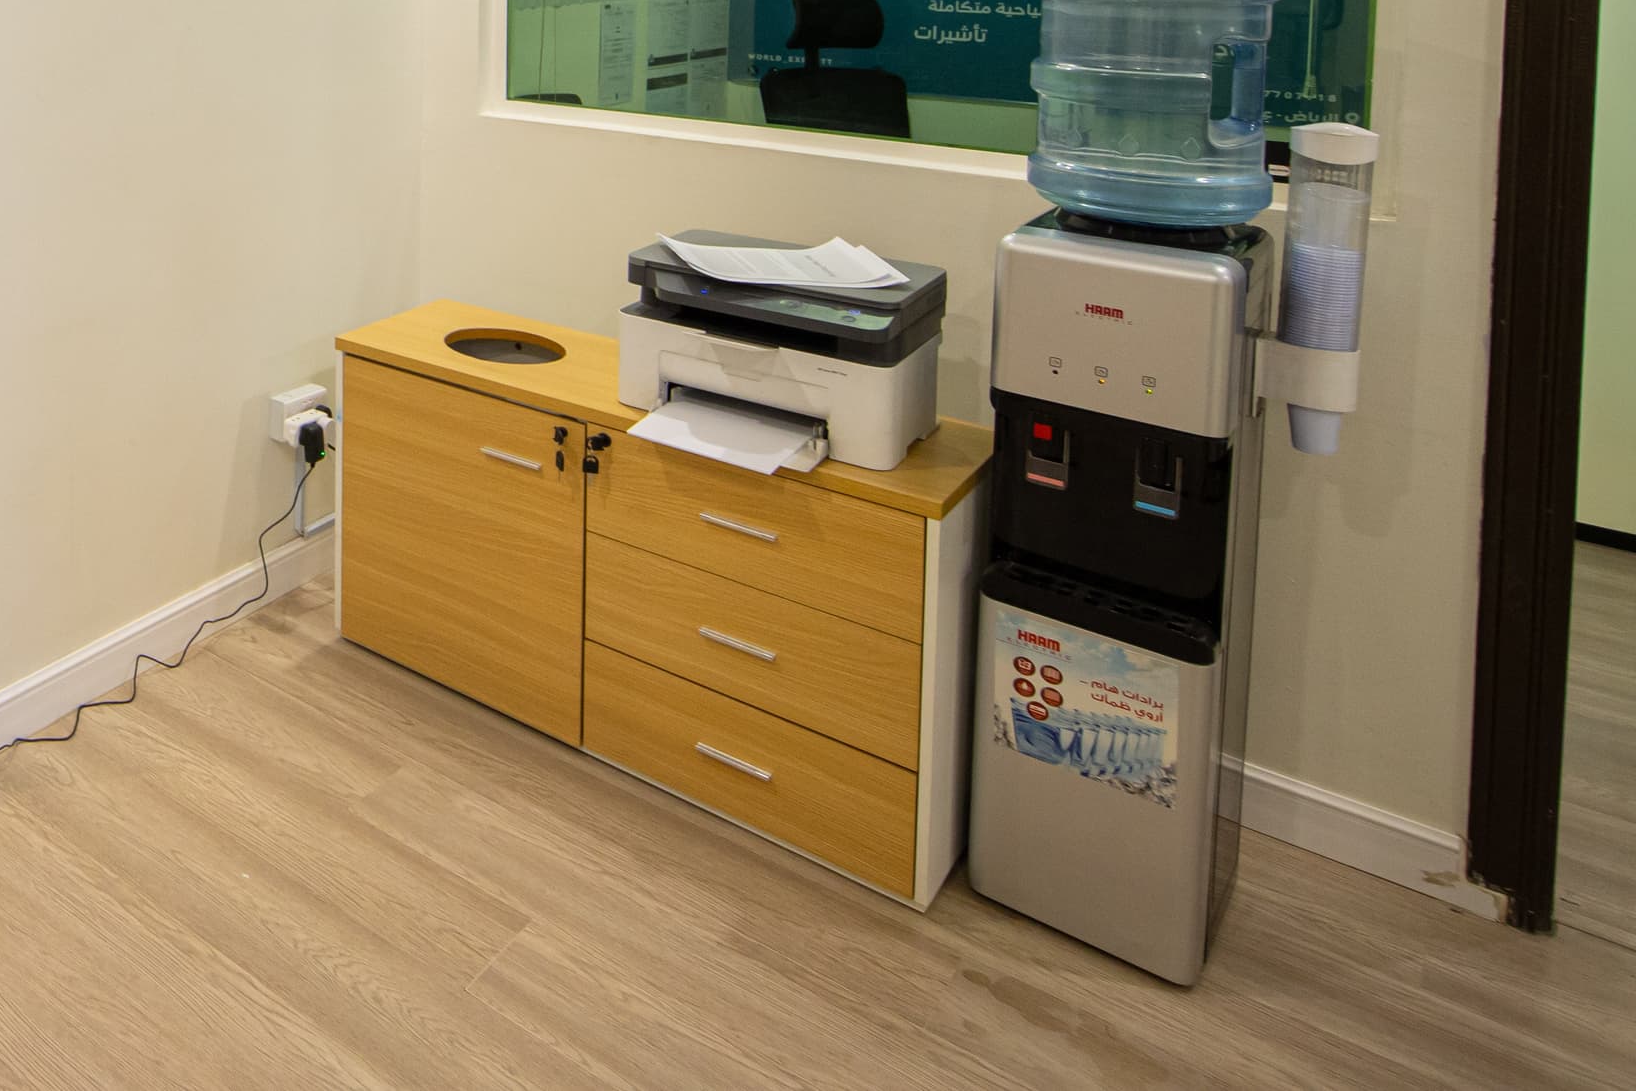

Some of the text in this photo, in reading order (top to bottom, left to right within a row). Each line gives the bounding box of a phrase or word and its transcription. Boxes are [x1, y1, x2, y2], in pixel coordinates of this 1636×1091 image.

[928, 0, 991, 15] متكاملة
[914, 23, 987, 44] تأشيرات
[1091, 680, 1118, 693] هام
[1121, 689, 1163, 709] برادات
